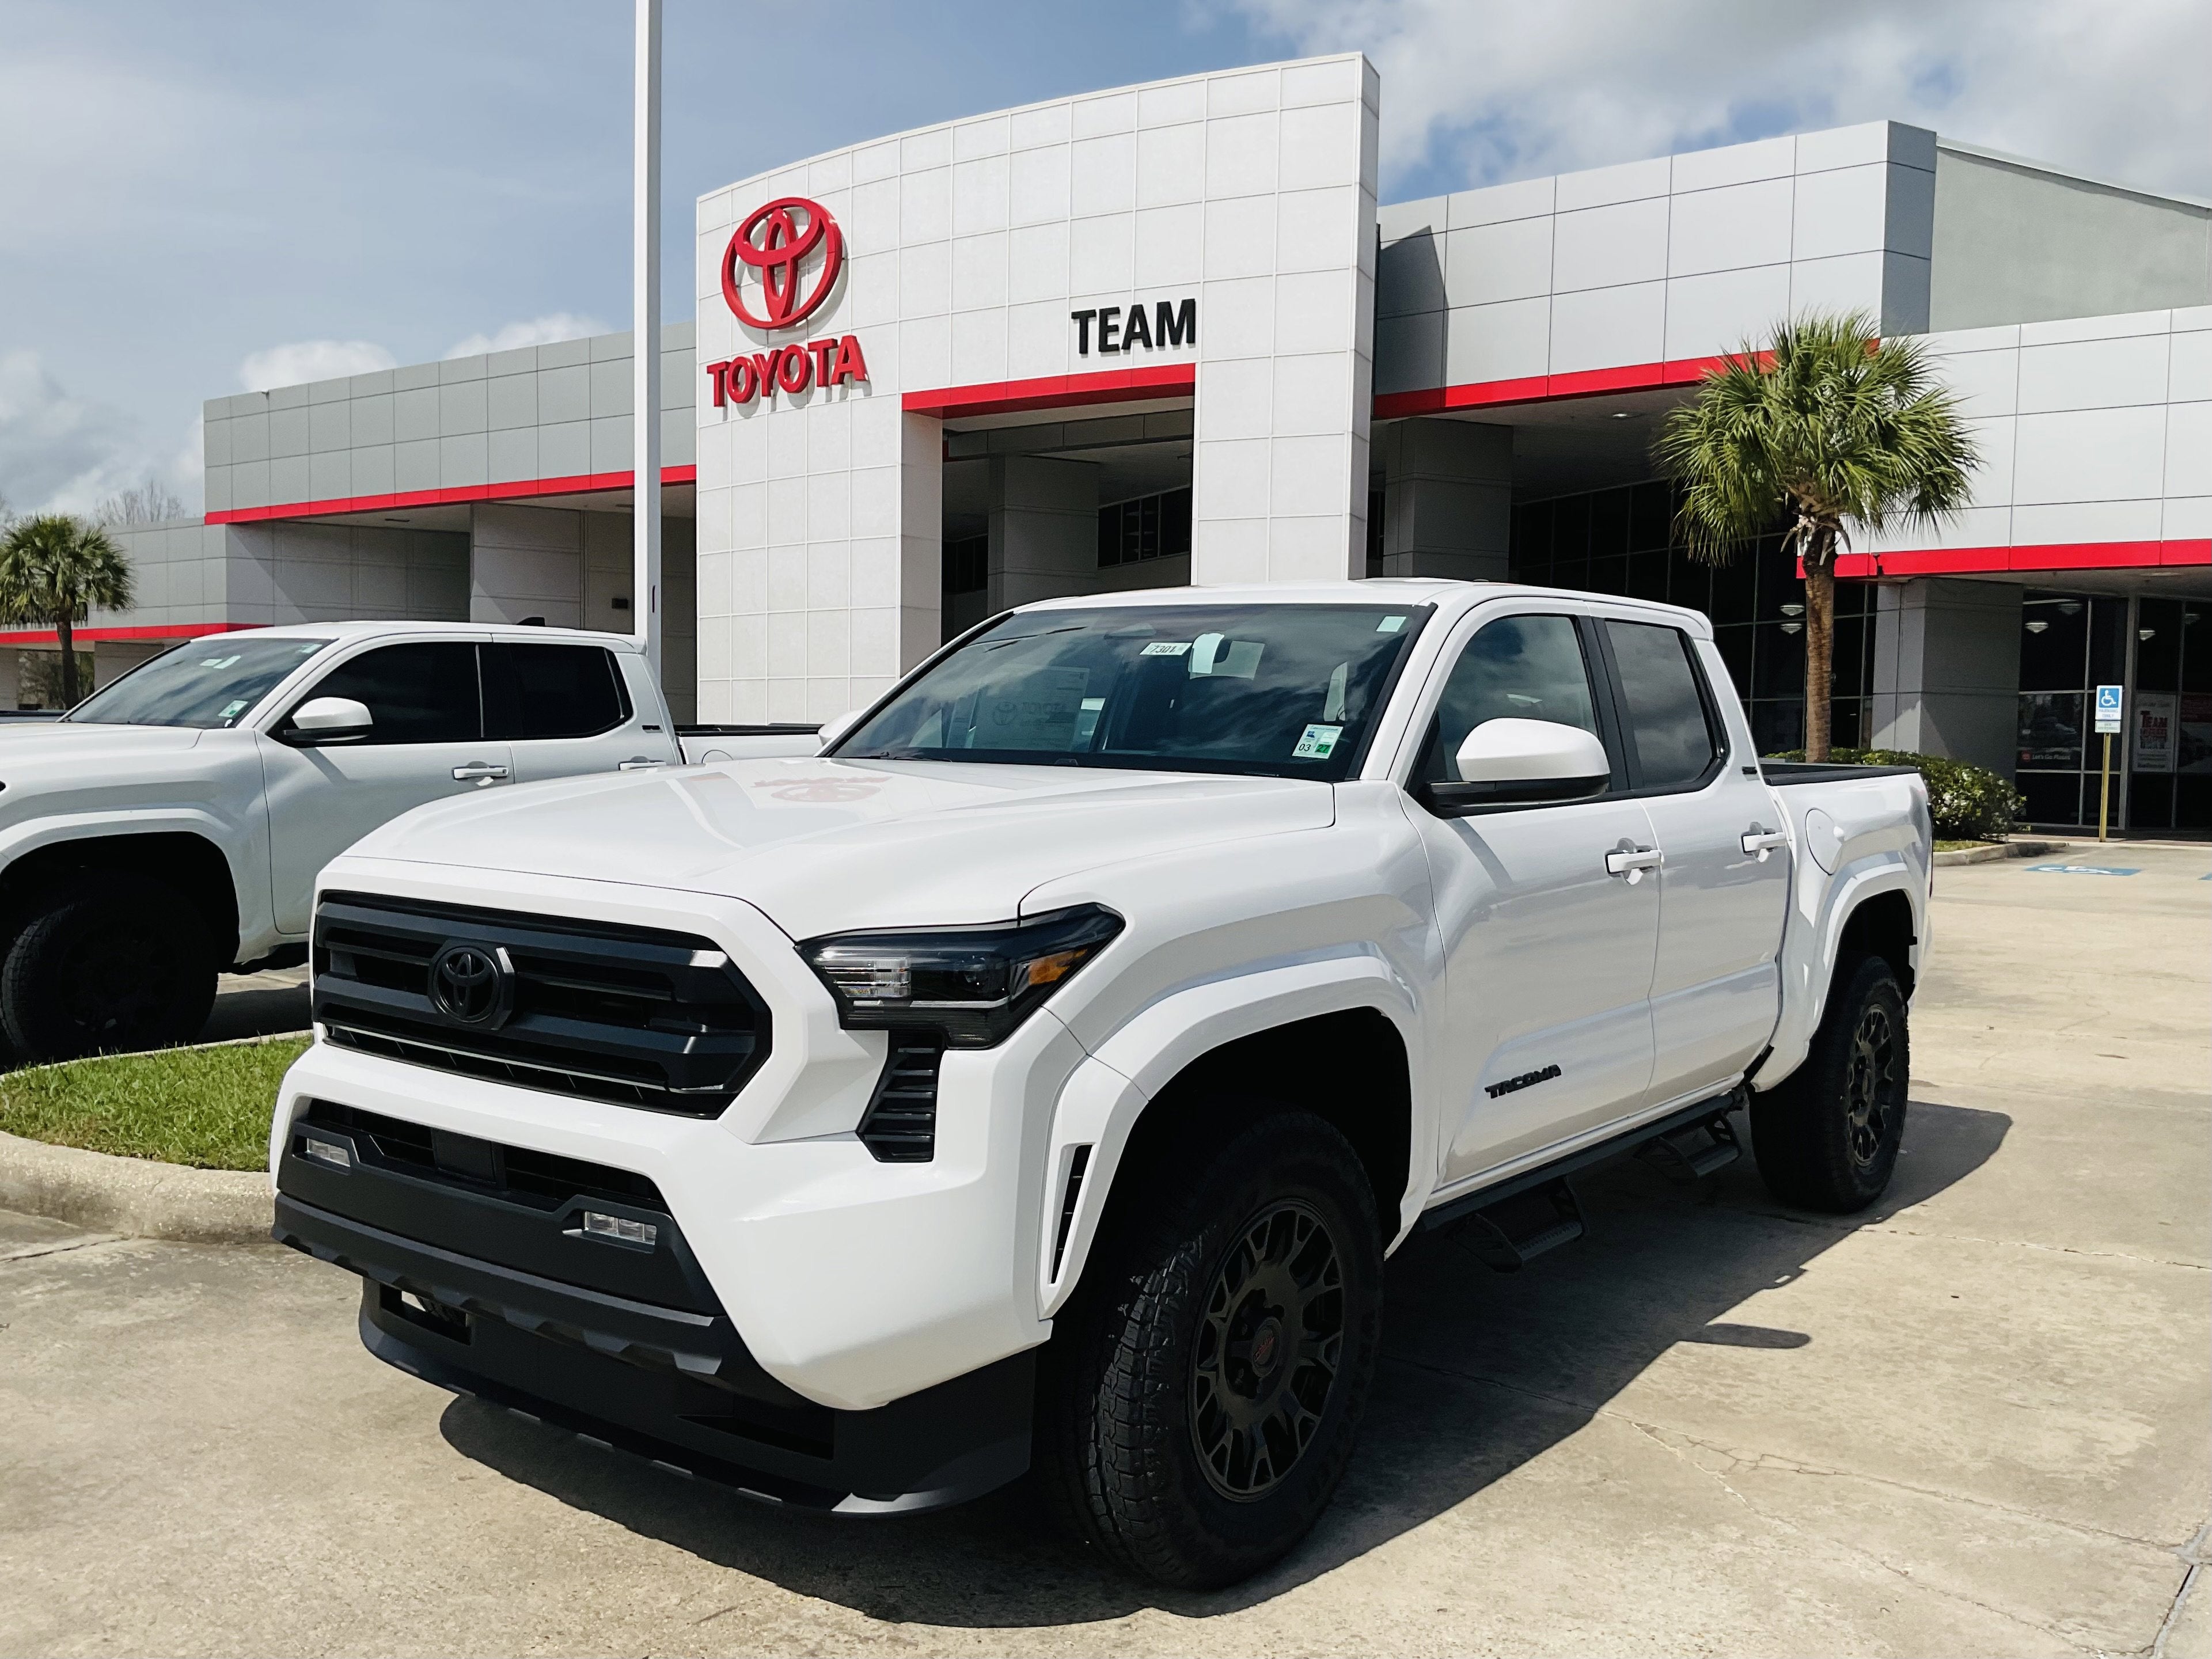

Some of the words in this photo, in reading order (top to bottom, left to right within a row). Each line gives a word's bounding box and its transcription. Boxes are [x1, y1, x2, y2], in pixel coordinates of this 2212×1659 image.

[1072, 298, 1196, 354] TEAM
[707, 335, 868, 408] TOYOTA
[1299, 743, 1311, 751] 03
[1316, 744, 1331, 753] 27
[1484, 1064, 1562, 1099] TACOMA
